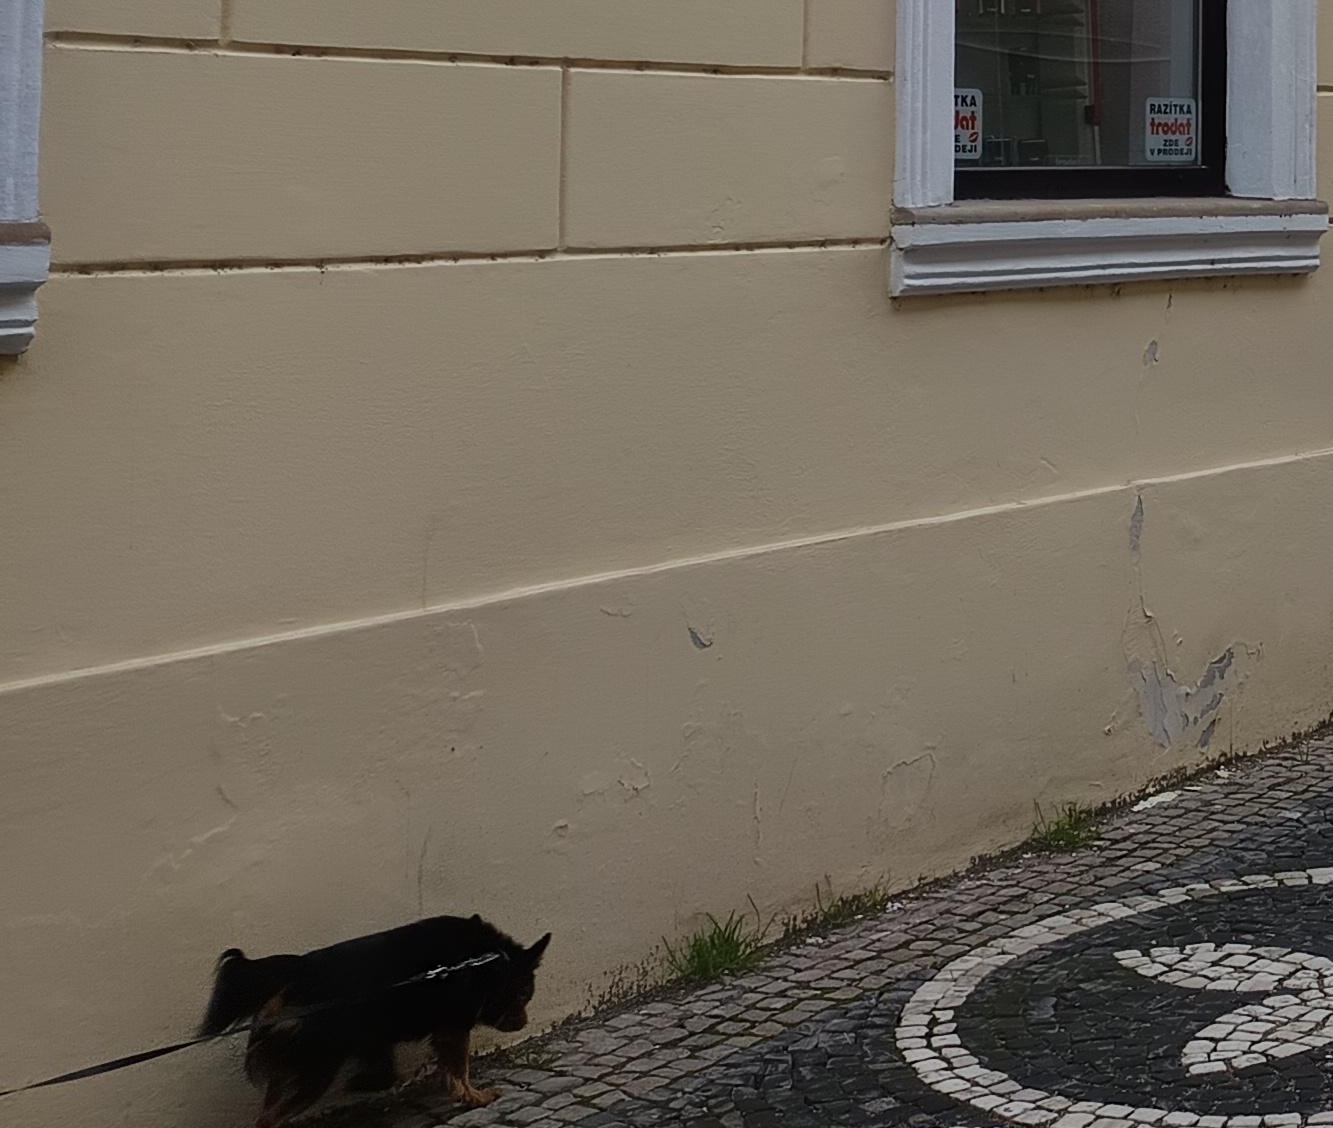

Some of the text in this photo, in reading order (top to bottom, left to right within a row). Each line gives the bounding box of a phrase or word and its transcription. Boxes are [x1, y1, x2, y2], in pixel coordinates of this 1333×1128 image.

[1149, 101, 1193, 115] RAZÍTKA
[1150, 116, 1192, 136] trodat
[1162, 138, 1180, 147] ZDE
